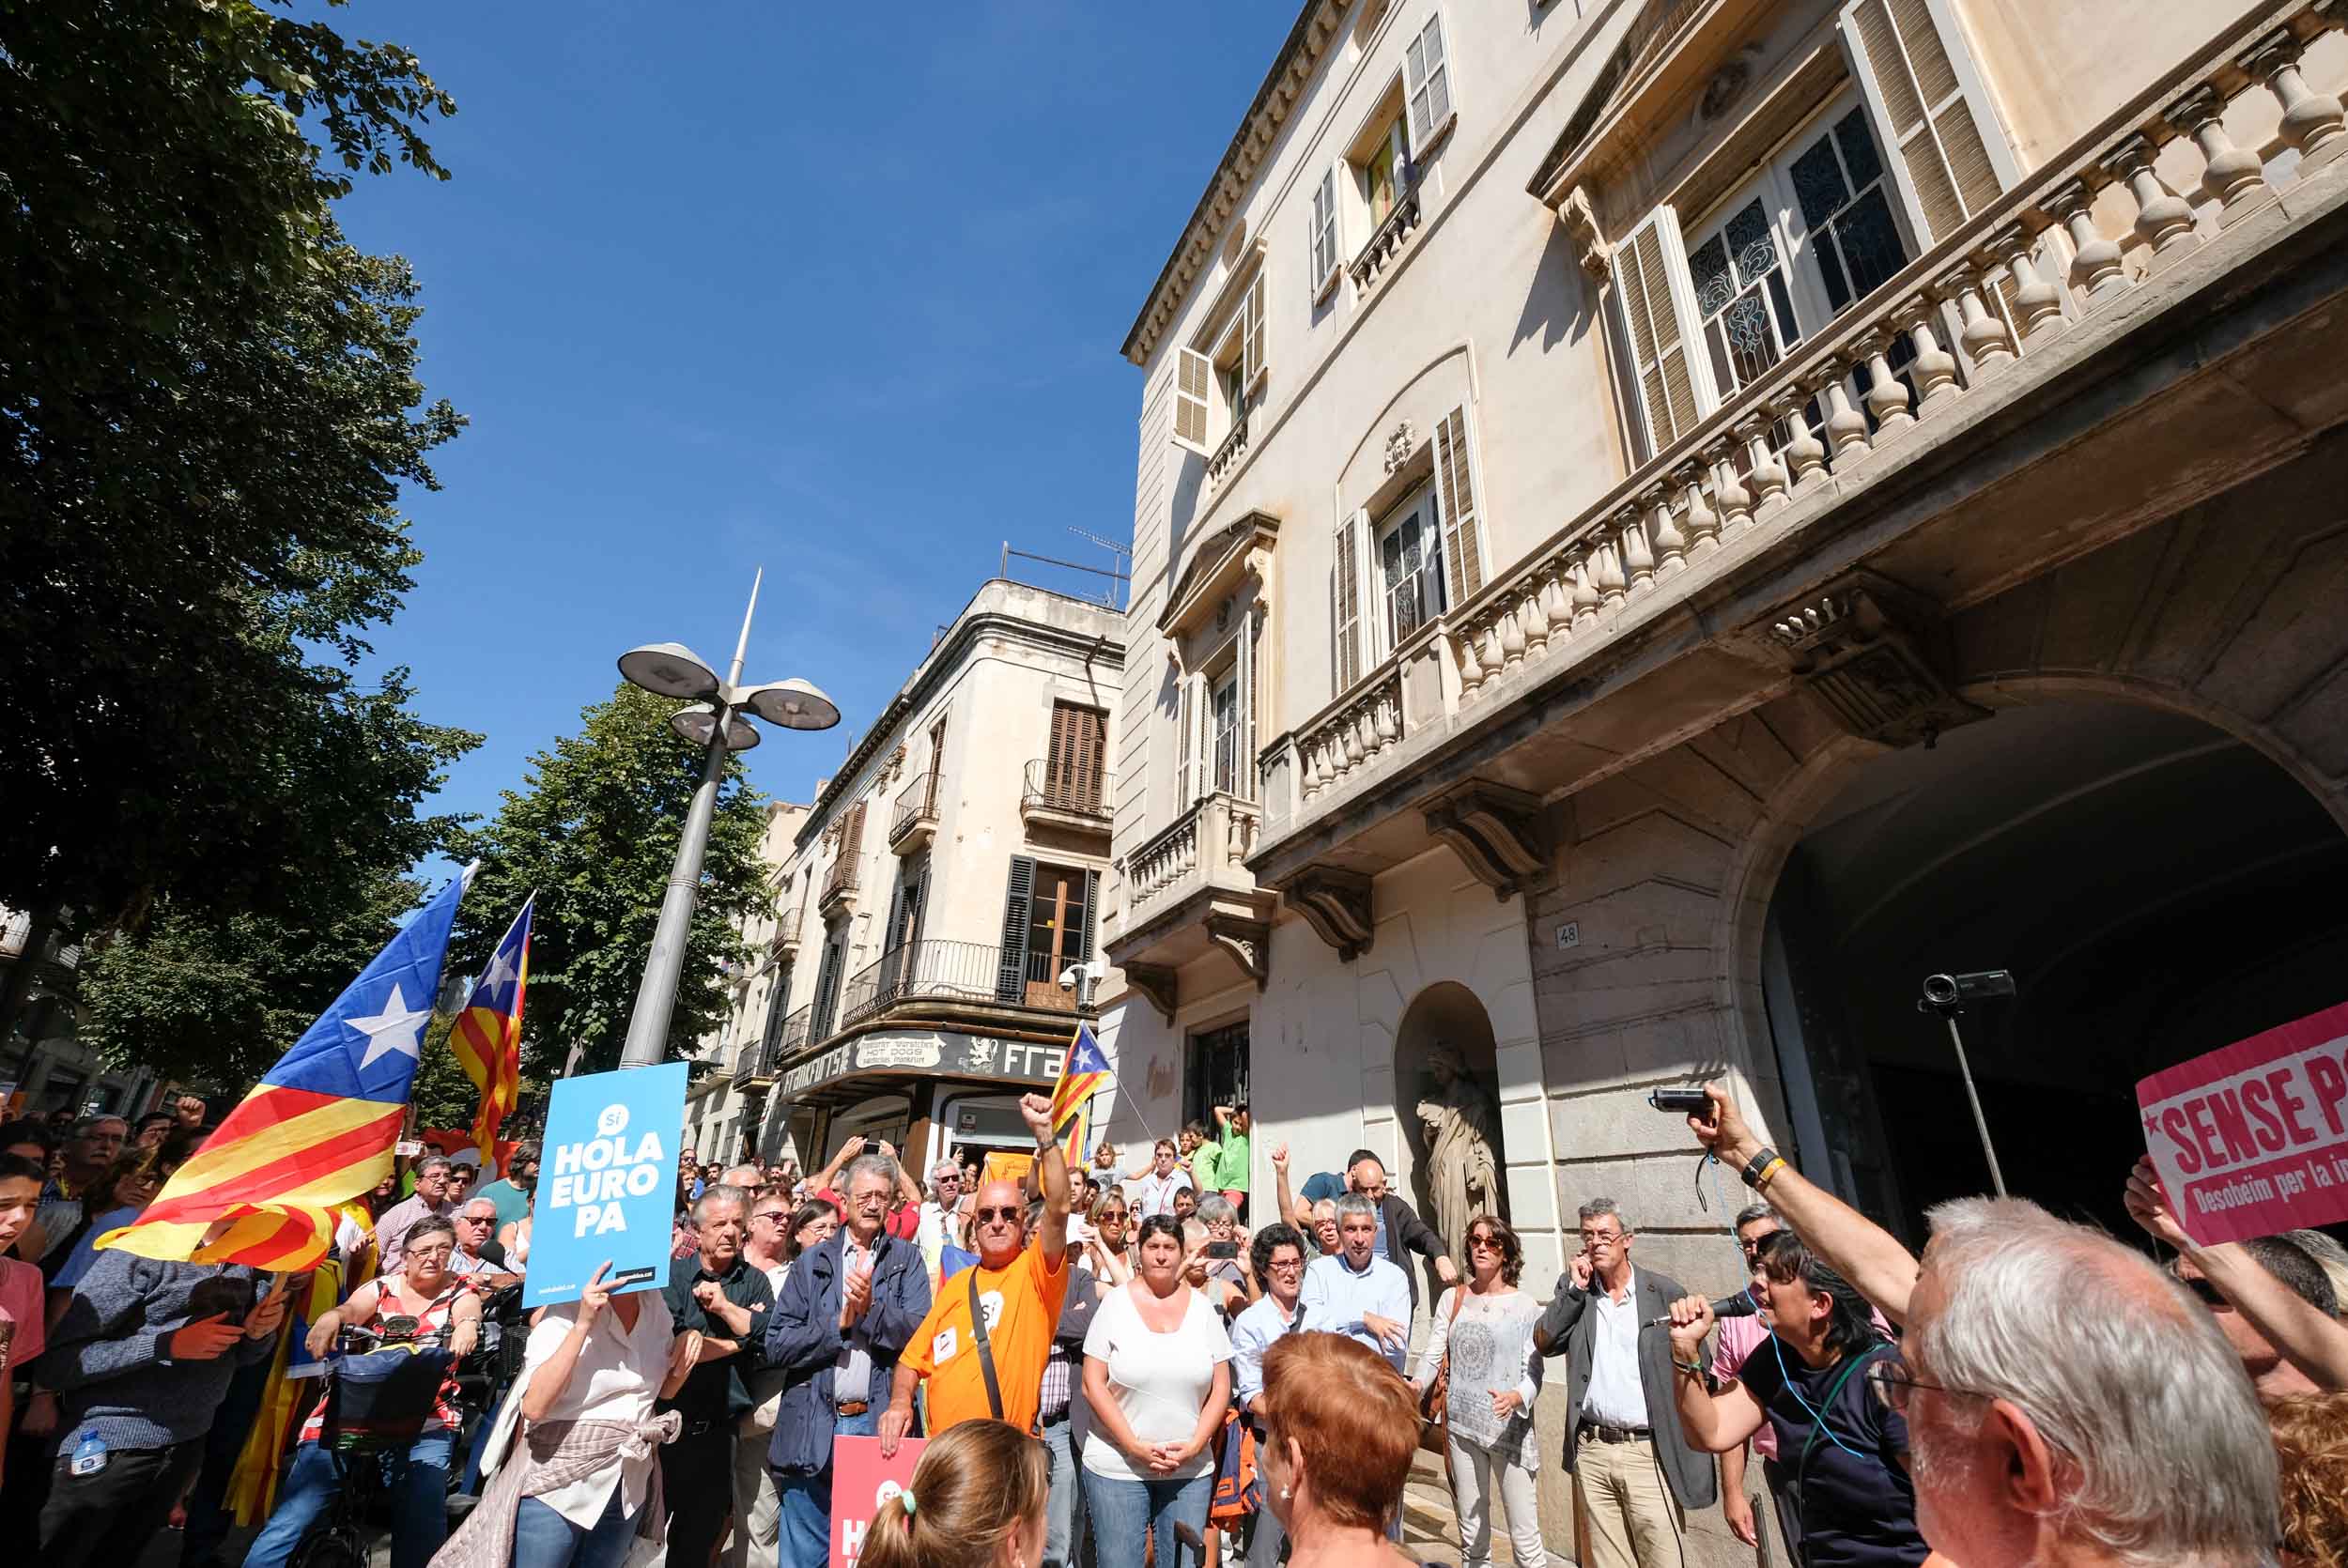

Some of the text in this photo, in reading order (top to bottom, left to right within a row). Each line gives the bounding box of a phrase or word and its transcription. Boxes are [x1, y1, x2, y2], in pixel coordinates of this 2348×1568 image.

[1561, 927, 1576, 944] 48
[2162, 1048, 2348, 1174] SENSE P
[554, 1131, 664, 1175] HOLA
[549, 1163, 659, 1208] EURO
[2276, 1170, 2307, 1203] per
[2307, 1161, 2333, 1188] la
[574, 1201, 627, 1238] PA
